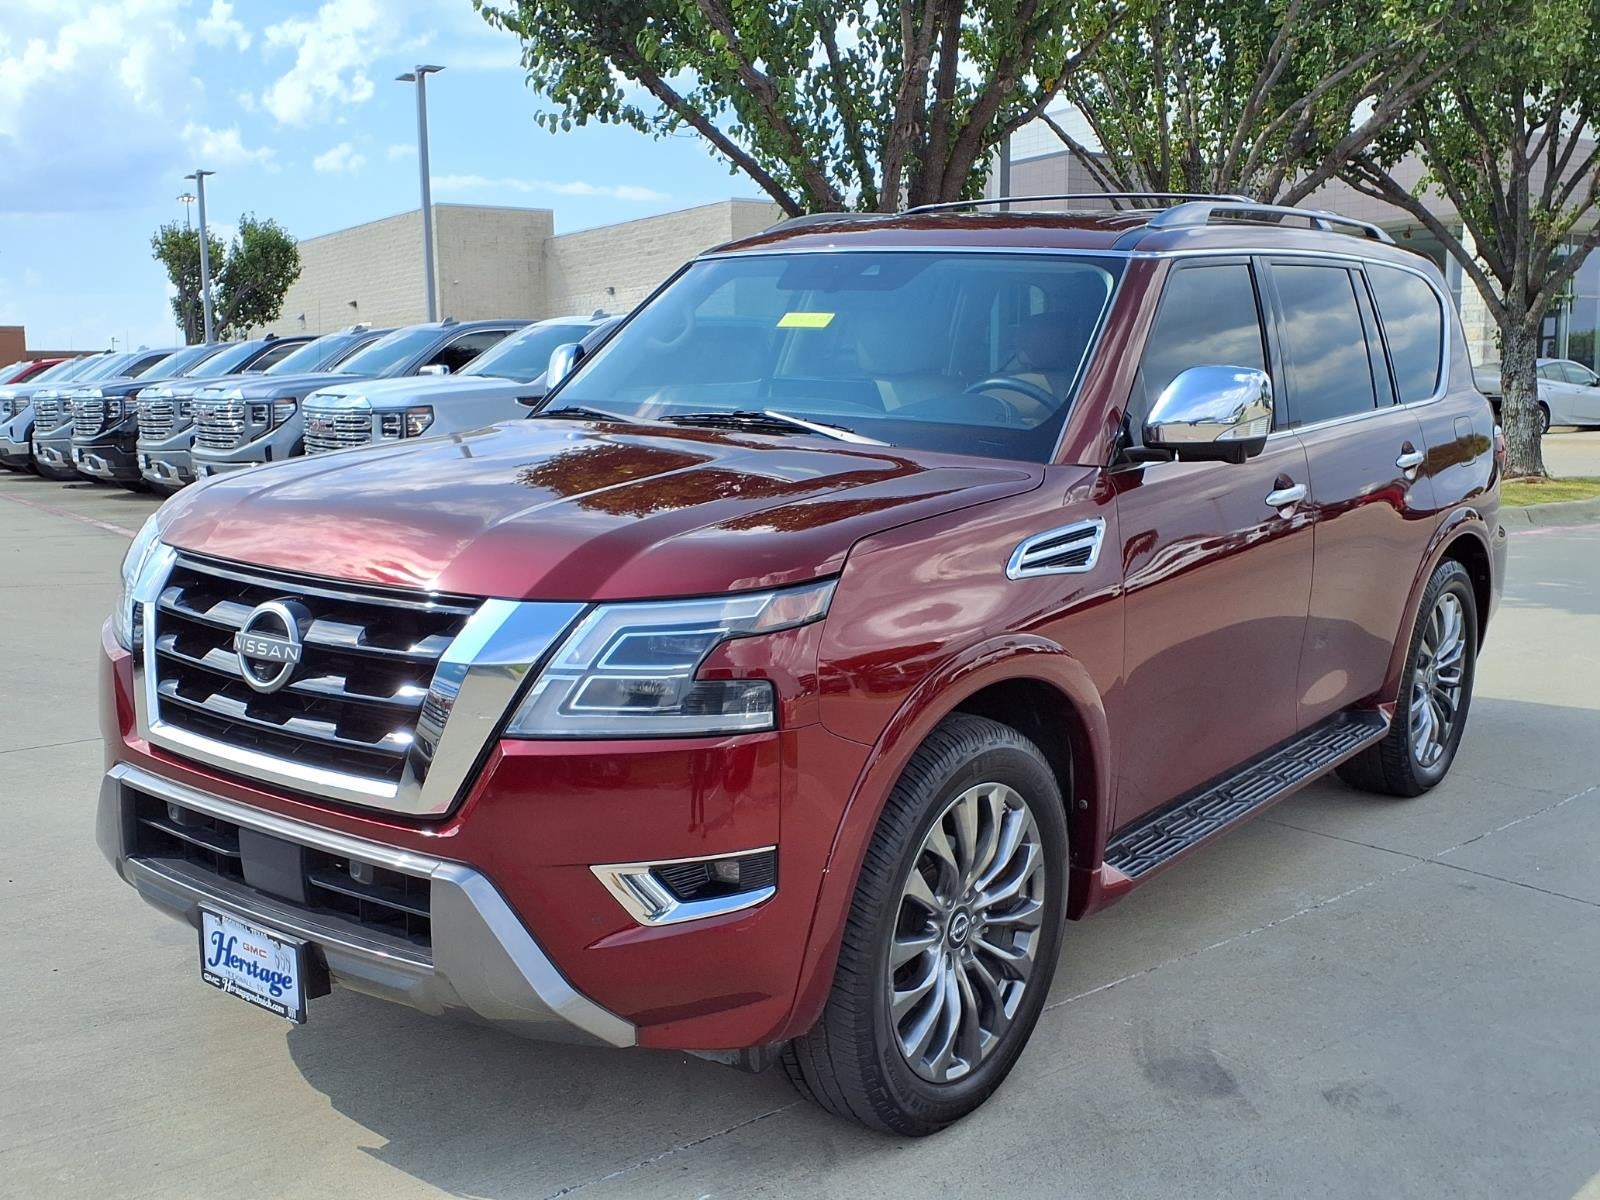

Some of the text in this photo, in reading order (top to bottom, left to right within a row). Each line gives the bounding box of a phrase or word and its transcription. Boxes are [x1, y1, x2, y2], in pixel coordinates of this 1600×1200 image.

[234, 635, 299, 661] NISSAN
[242, 942, 268, 959] GMC
[207, 931, 293, 997] Heritage
